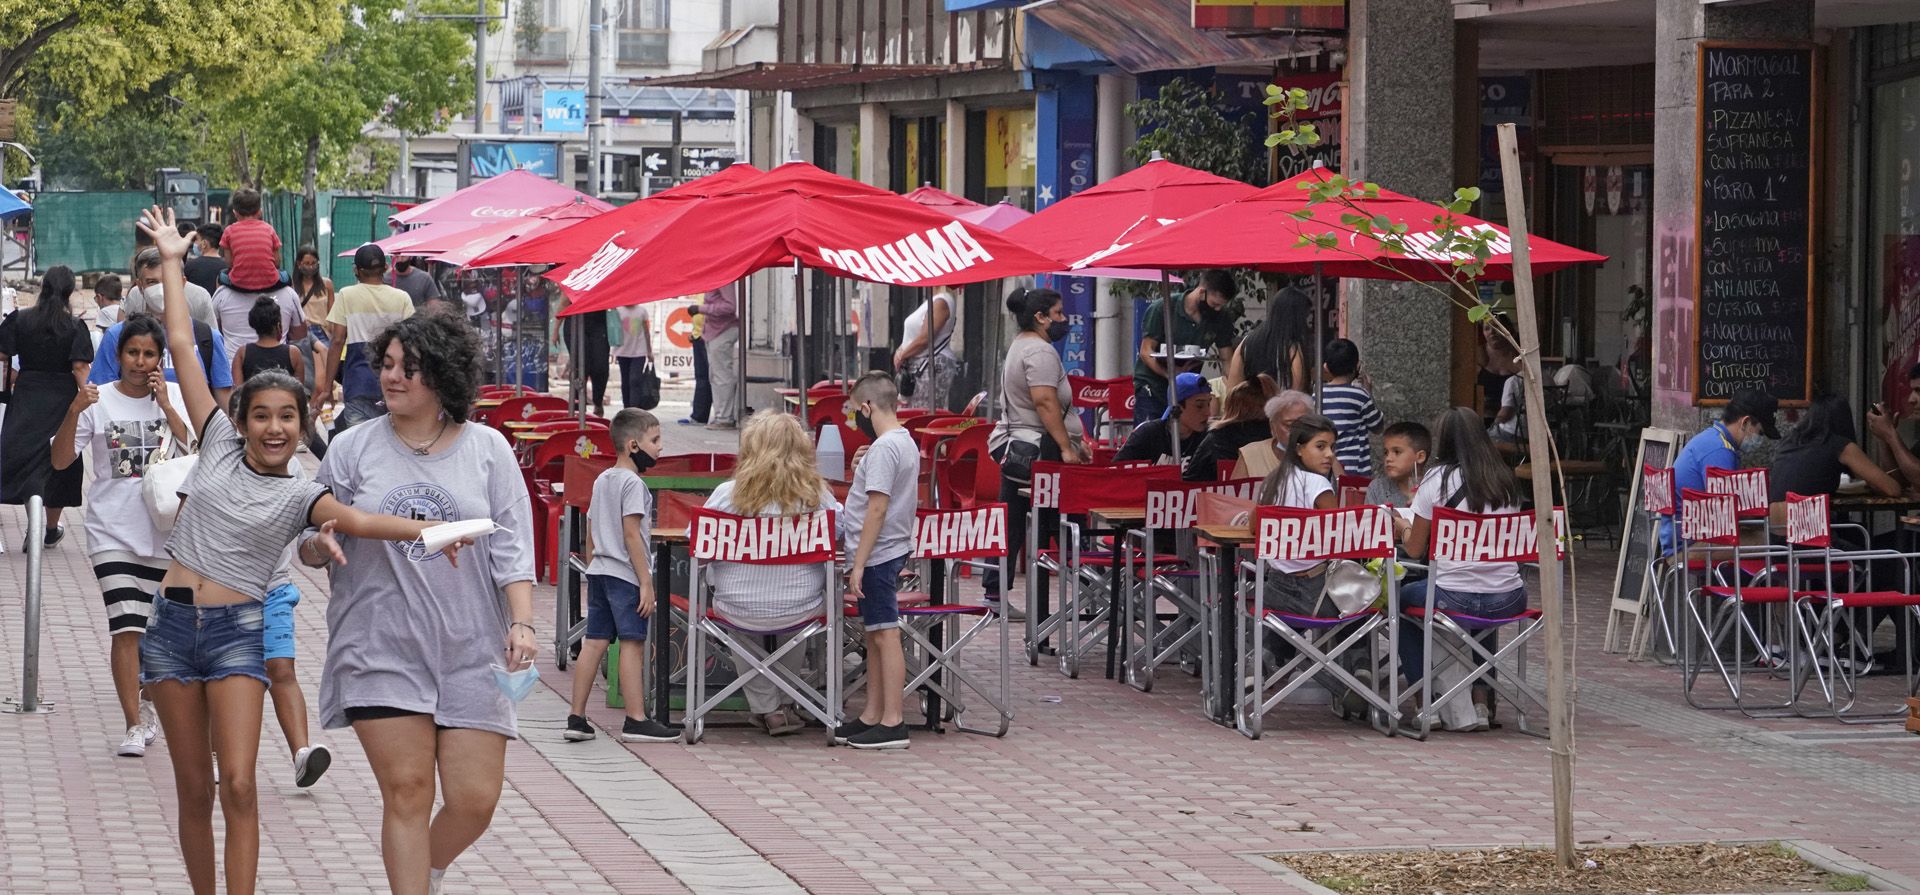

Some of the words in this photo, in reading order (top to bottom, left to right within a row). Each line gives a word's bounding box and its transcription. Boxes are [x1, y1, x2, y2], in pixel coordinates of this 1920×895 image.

[1708, 81, 1753, 102] PARA
[1762, 78, 1775, 98] 2
[545, 103, 581, 119] wifi
[1710, 153, 1736, 170] CON
[664, 355, 693, 367] DESV
[386, 488, 420, 511] PREMIUM
[425, 488, 454, 517] QUALITY
[399, 501, 412, 514] LOS
[412, 499, 440, 517] ANGELES
[1682, 496, 1737, 540] BRAHMA
[1786, 496, 1828, 544] BRAHMA
[695, 510, 832, 561] BRAHMA
[1258, 508, 1394, 560] BRAHMA
